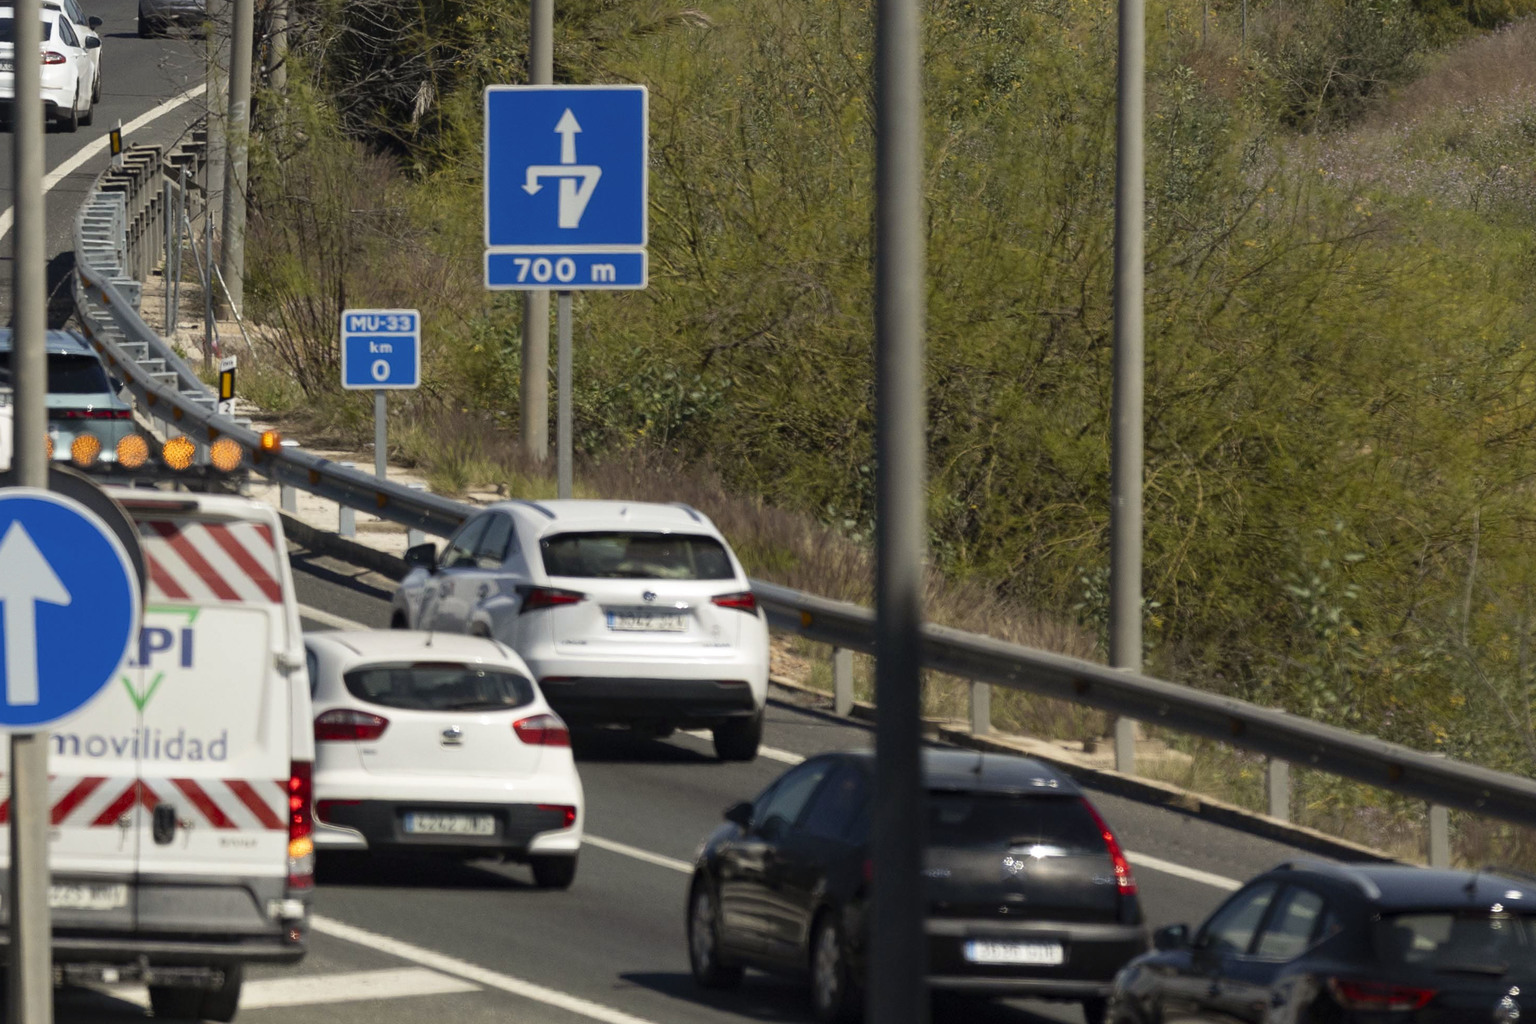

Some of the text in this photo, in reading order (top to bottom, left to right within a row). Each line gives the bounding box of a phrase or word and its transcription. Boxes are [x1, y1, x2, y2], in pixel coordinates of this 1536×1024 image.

[513, 258, 616, 282] 700 m
[350, 315, 412, 333] MU-33
[369, 341, 393, 354] km
[371, 360, 391, 382] 0
[128, 627, 193, 668] PI
[51, 728, 229, 762] movilidad
